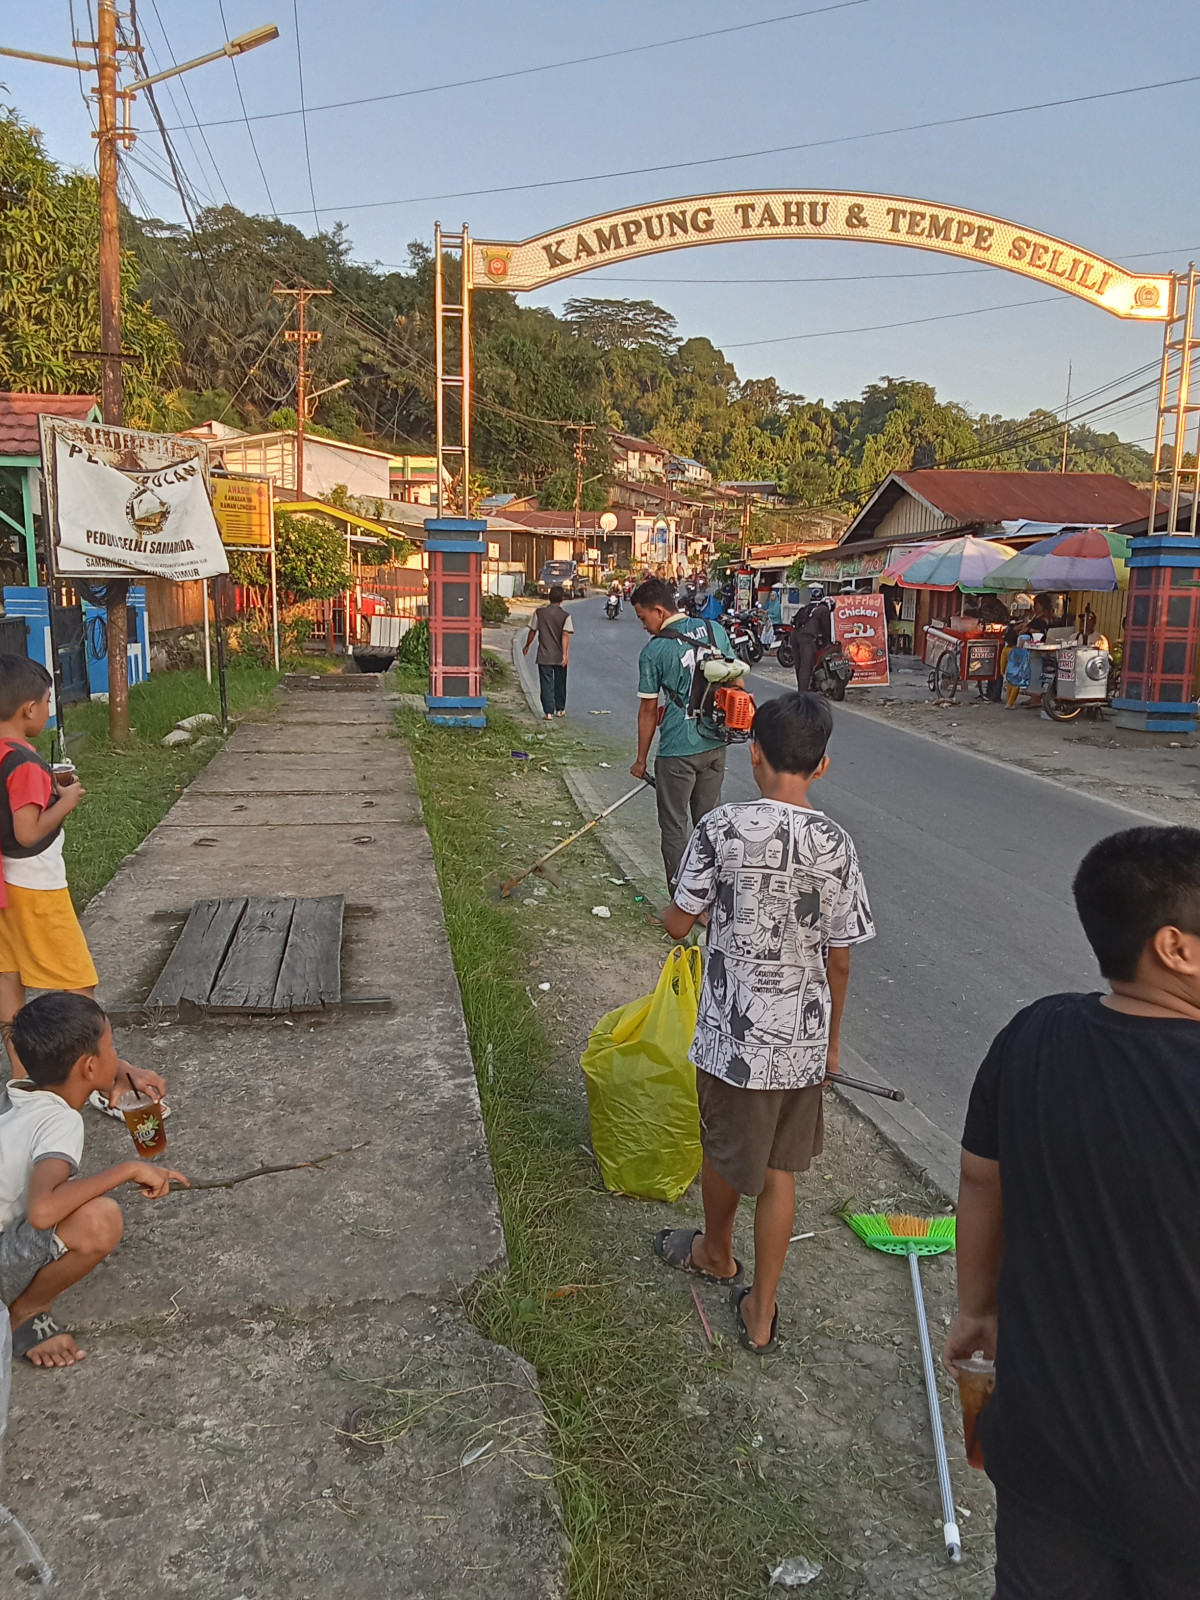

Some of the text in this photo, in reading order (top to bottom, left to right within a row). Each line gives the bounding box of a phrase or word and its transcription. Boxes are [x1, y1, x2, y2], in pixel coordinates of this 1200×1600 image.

[540, 201, 1114, 296] KAMPUNG TAHU & TEMPE SELILI
[855, 595, 881, 607] Fried
[838, 606, 879, 619] Chicken
